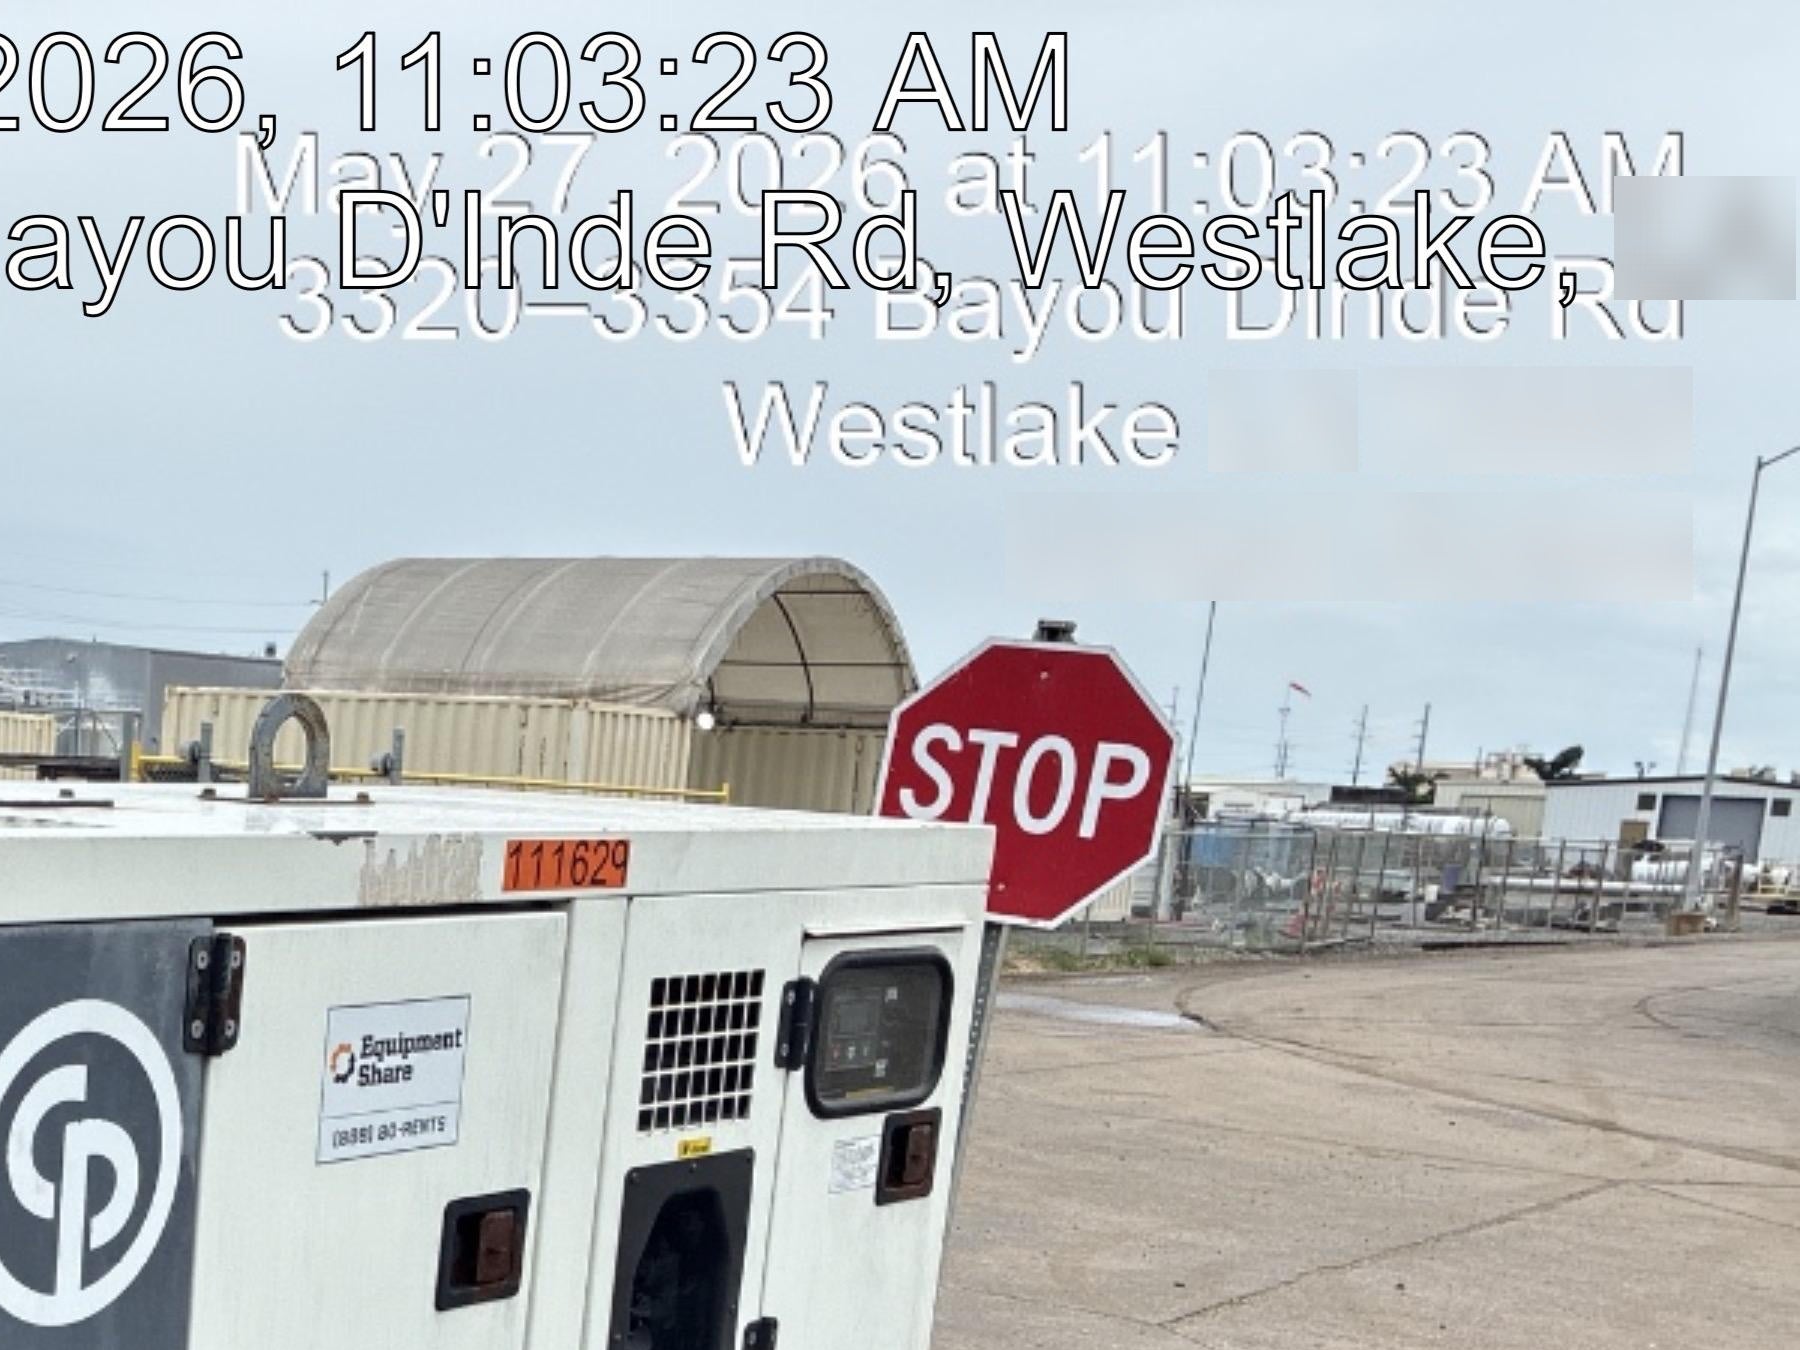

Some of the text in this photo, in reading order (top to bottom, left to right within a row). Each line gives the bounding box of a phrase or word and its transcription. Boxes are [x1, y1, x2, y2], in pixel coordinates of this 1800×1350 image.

[899, 722, 1151, 840] STOP
[509, 839, 629, 889] 111629
[360, 1028, 463, 1062] Equipment
[357, 1063, 414, 1088] Share
